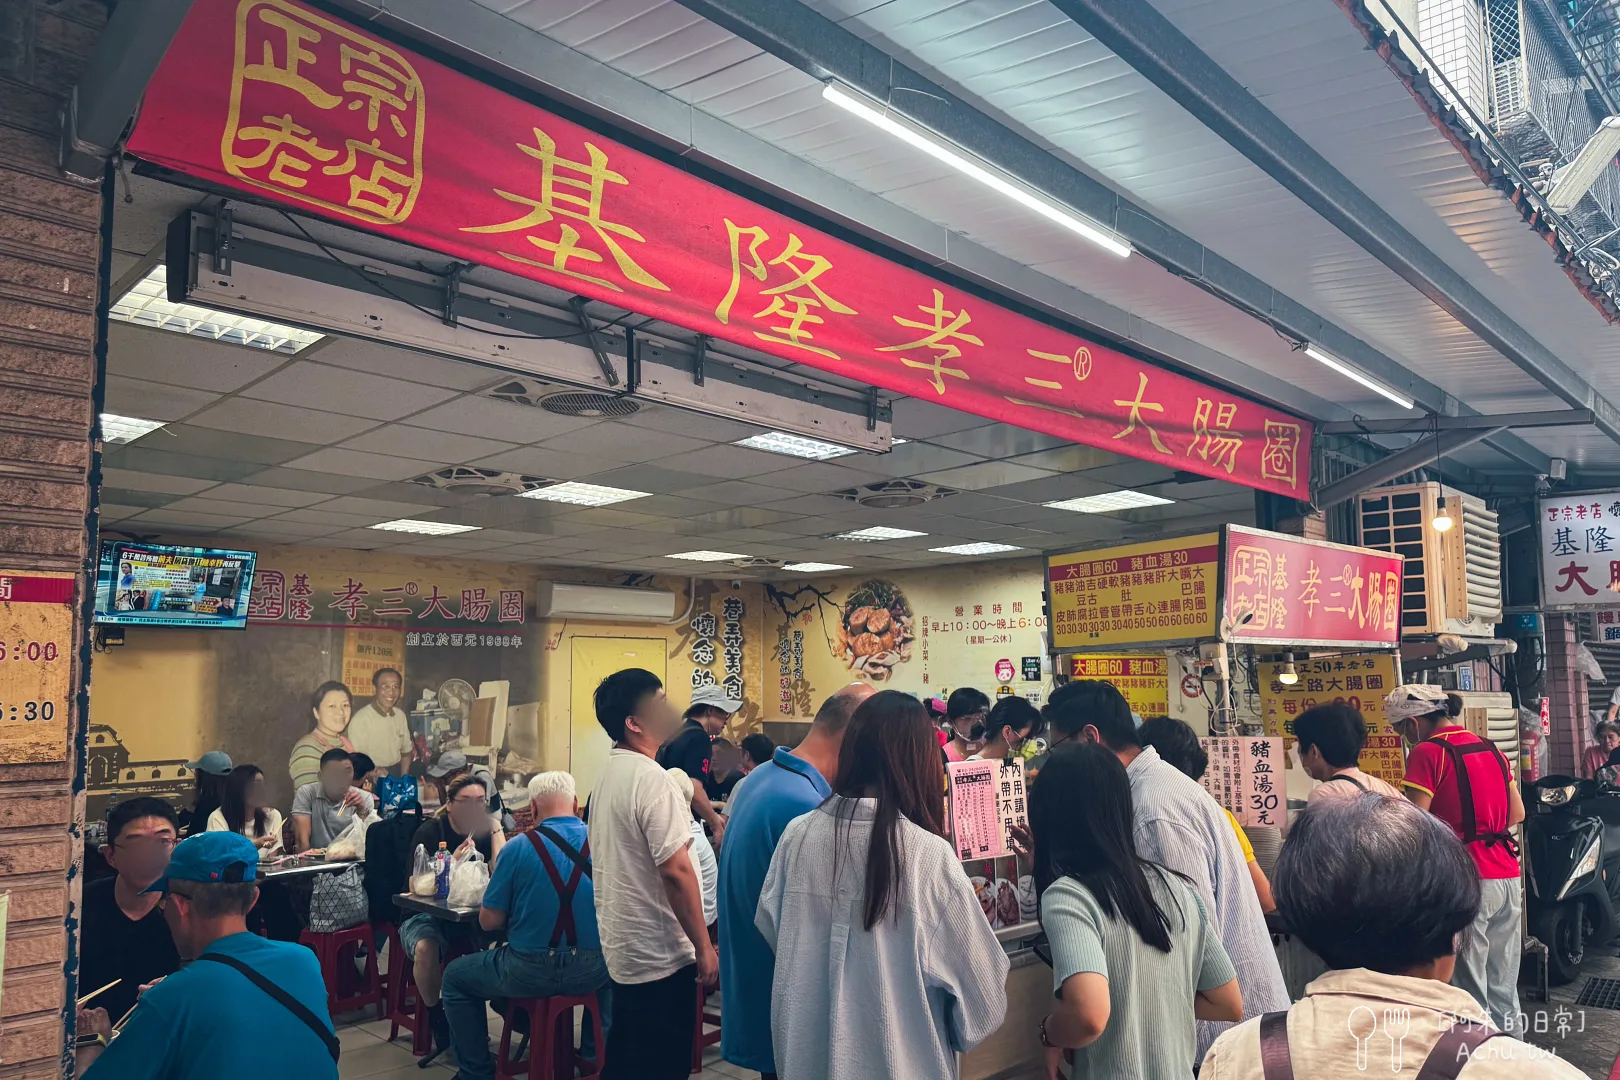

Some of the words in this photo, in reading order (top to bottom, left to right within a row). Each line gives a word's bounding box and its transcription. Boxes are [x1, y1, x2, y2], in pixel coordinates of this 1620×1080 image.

[243, 8, 419, 137] 正宗
[238, 113, 415, 216] 老店
[1547, 502, 1602, 521] 正宗老店
[1550, 526, 1616, 557] 基隆
[1066, 560, 1118, 578] 大腸圈60
[1130, 550, 1188, 571] 豬血湯30
[1233, 552, 1269, 588] 正宗
[289, 573, 315, 621] 基隆
[1270, 552, 1290, 630] 基隆
[954, 601, 1023, 617] 營業時間
[1100, 620, 1110, 631] 30
[1111, 619, 1122, 630] 30
[1122, 618, 1133, 630] 40
[1134, 617, 1145, 629] 50
[1146, 615, 1158, 628] 50
[1158, 614, 1170, 627] 60
[1170, 613, 1182, 626] 60
[1183, 612, 1195, 625] 60
[1195, 611, 1208, 624] 60
[1056, 624, 1066, 635] 30
[1067, 623, 1077, 634] 30
[1077, 622, 1088, 633] 30
[1089, 621, 1099, 632] 30
[722, 596, 744, 699] 巷弄美食
[1074, 659, 1122, 675] 大腸圈60
[1272, 658, 1375, 676] 基正50年老店
[0, 701, 54, 721] :30
[1333, 695, 1376, 713] 0元
[1250, 740, 1279, 825] 豬血湯30元
